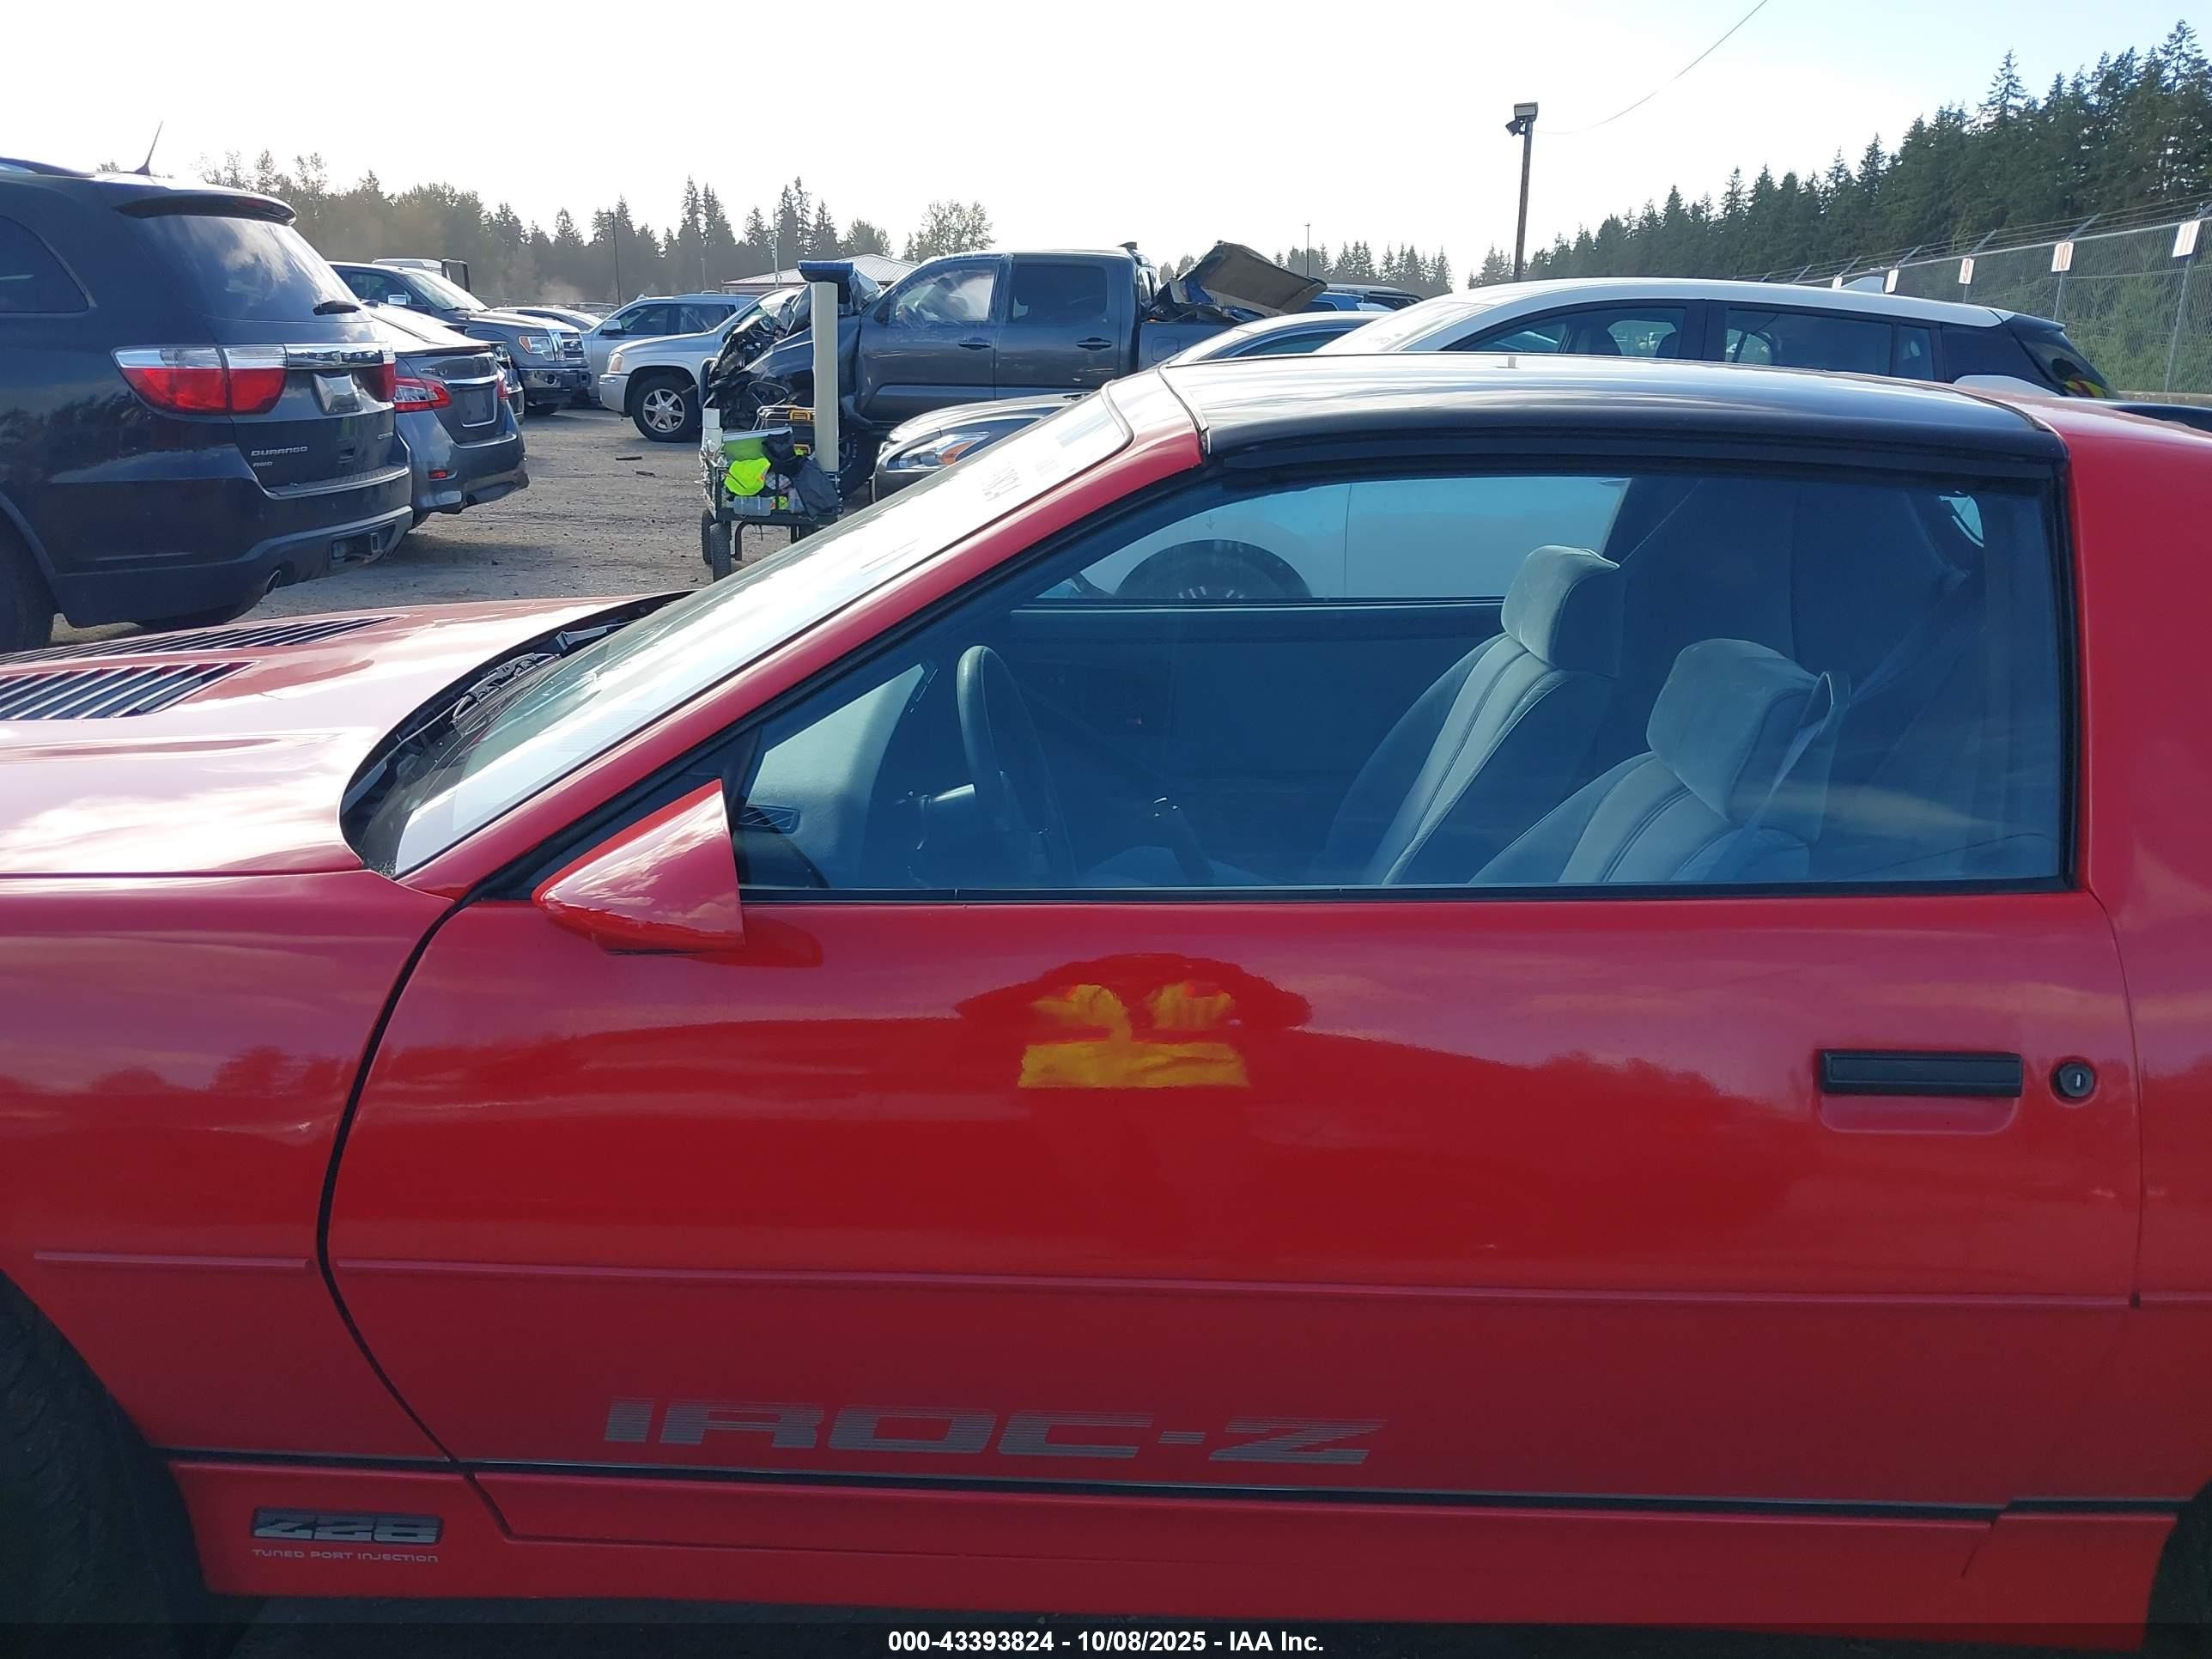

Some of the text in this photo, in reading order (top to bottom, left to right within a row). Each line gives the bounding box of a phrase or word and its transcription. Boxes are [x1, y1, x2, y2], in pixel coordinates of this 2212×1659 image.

[2055, 244, 2069, 270] 10
[251, 446, 308, 457] DURANGO
[603, 1396, 1389, 1466] IROC-Z
[252, 1510, 439, 1544] Z28
[252, 1548, 439, 1563] TUNED PORT INJECTION
